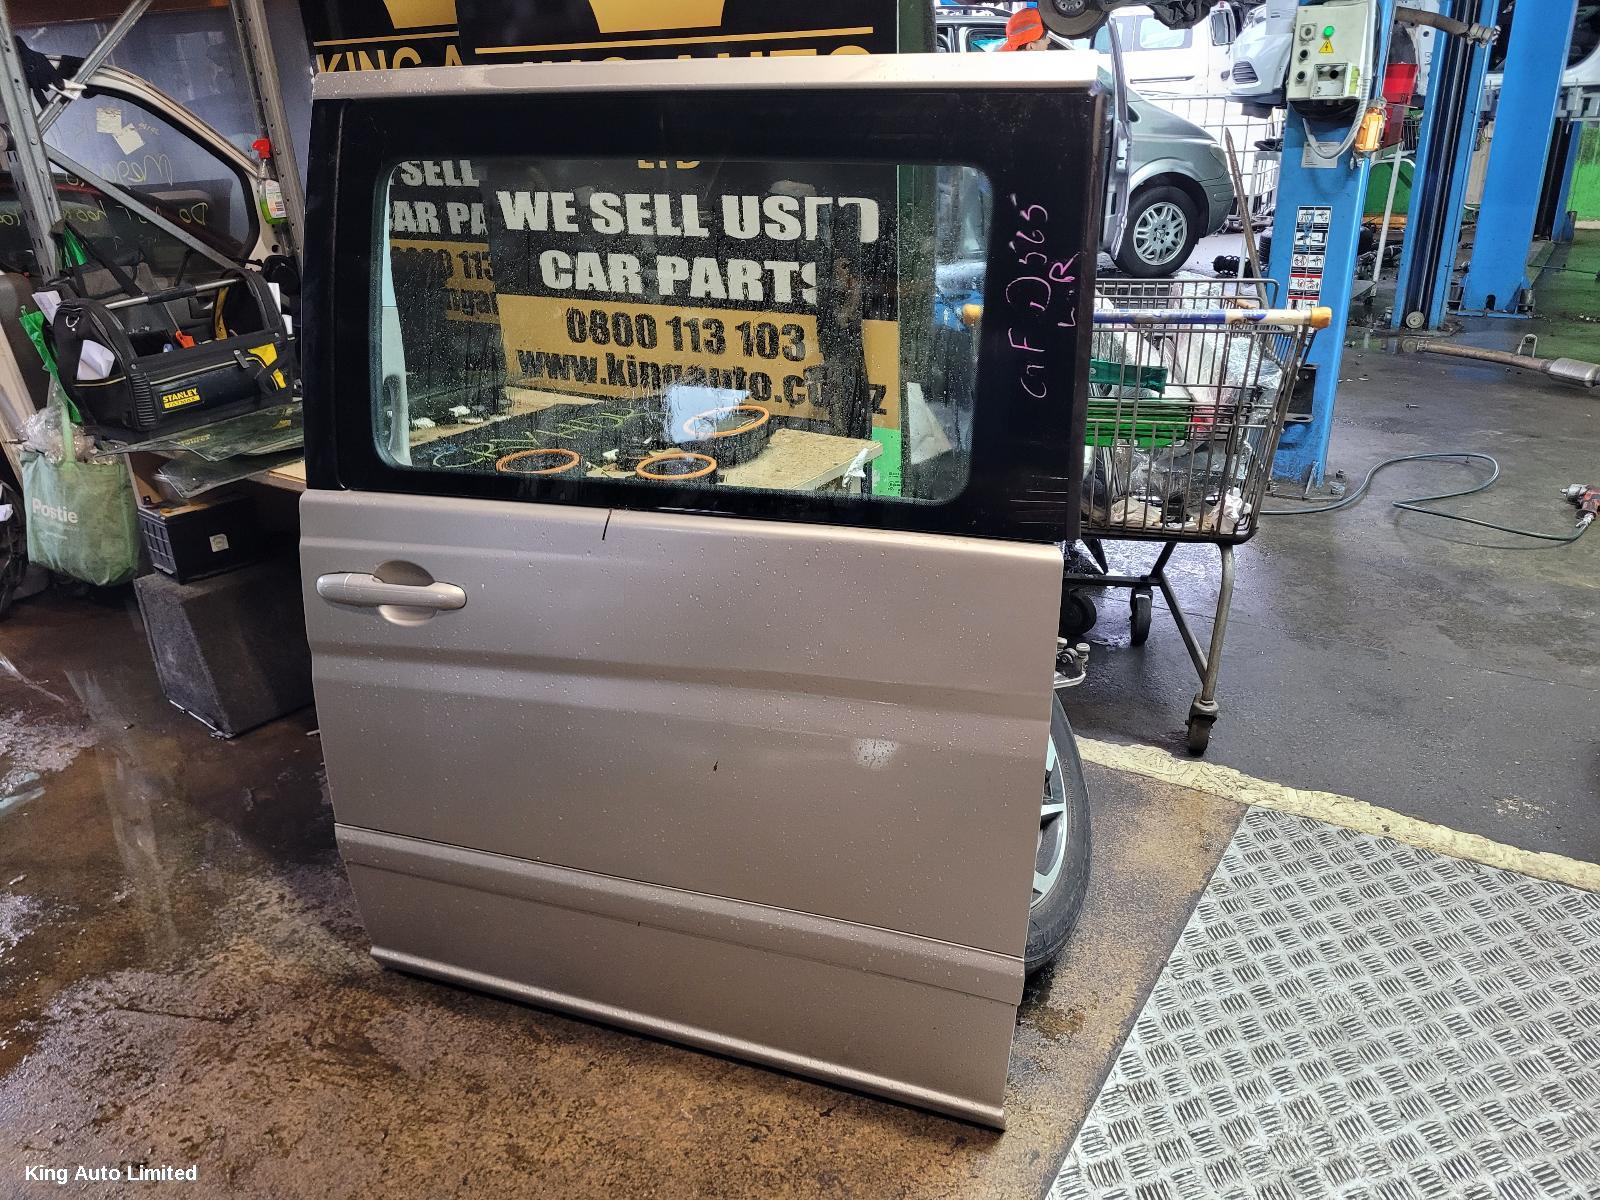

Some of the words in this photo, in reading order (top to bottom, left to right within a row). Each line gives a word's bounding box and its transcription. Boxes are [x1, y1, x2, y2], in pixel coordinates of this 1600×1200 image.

[390, 200, 441, 234] AR
[497, 190, 580, 233] WE
[590, 193, 709, 237] SELL
[540, 250, 643, 294] CAR
[566, 307, 657, 350] 0800
[665, 315, 726, 355] 113
[735, 320, 806, 362] 103
[162, 387, 199, 403] STANLEY
[32, 497, 79, 524] Postie
